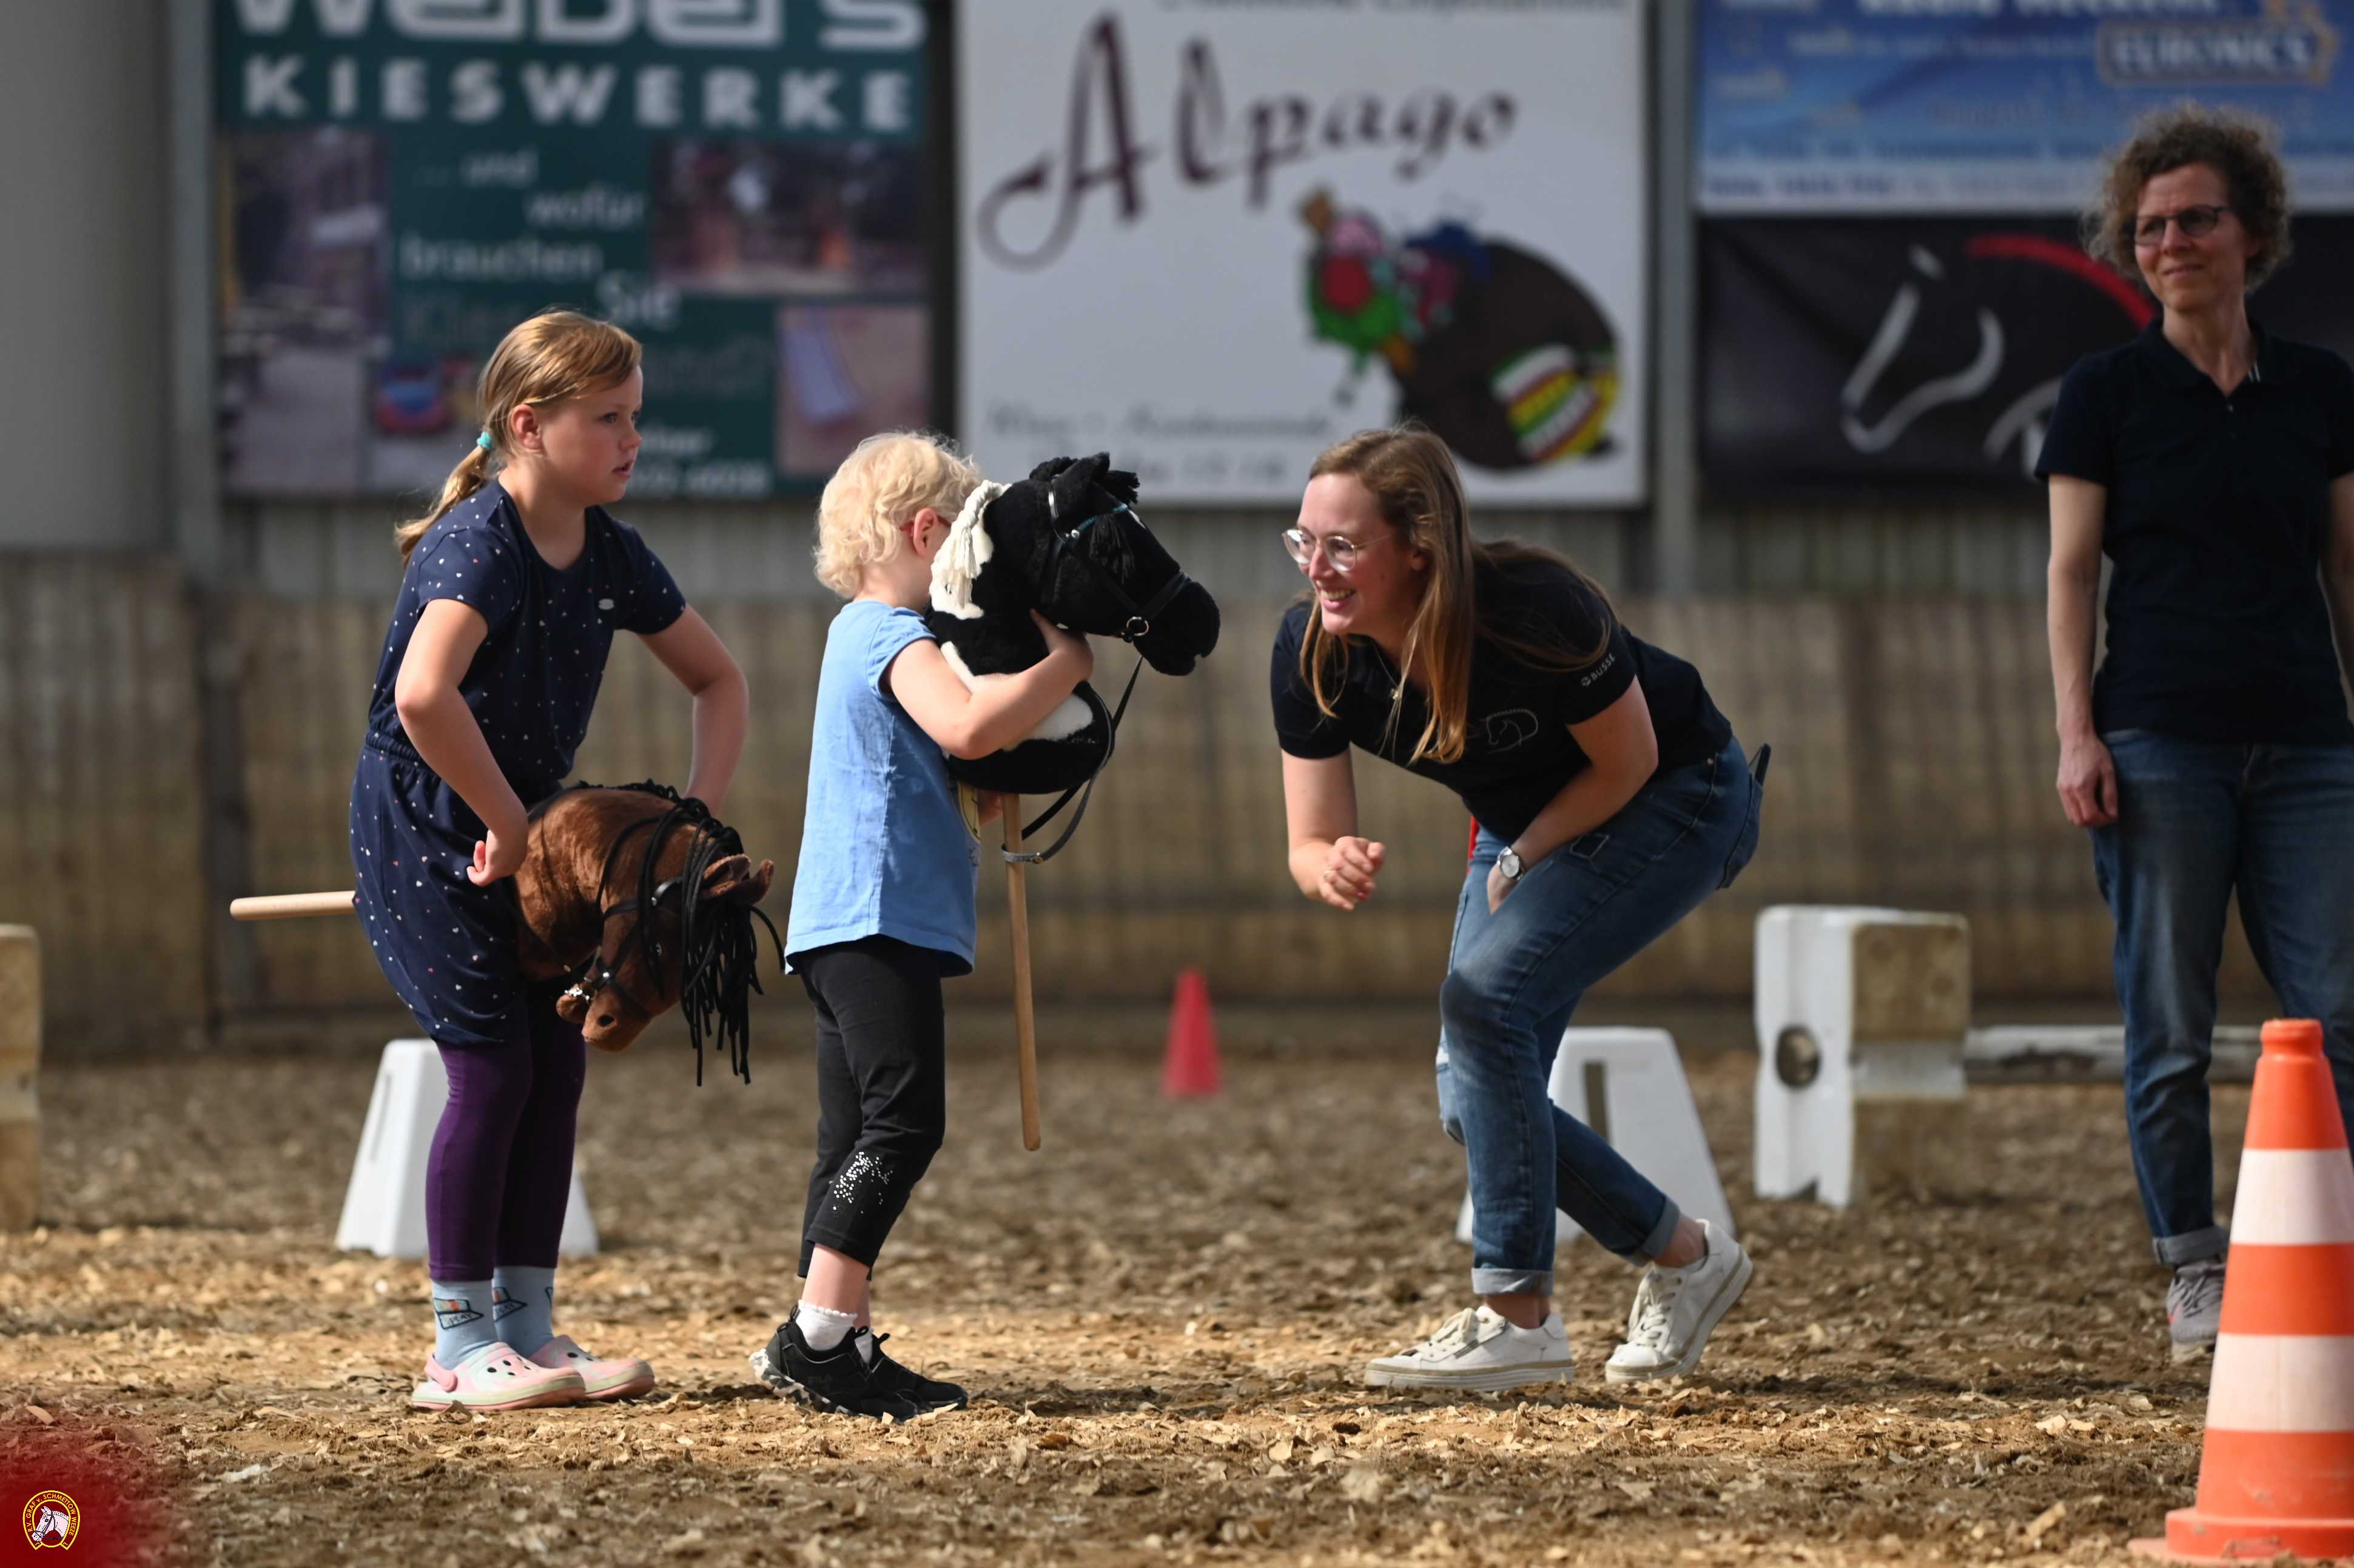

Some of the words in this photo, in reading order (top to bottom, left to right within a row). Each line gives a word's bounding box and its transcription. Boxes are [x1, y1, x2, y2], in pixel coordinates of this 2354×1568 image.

[244, 55, 914, 132] KIESWERKE
[463, 149, 539, 186] und
[975, 11, 1516, 273] Alpago
[526, 183, 644, 228] wofür
[401, 233, 603, 280] brauchen
[597, 275, 679, 331] Sie
